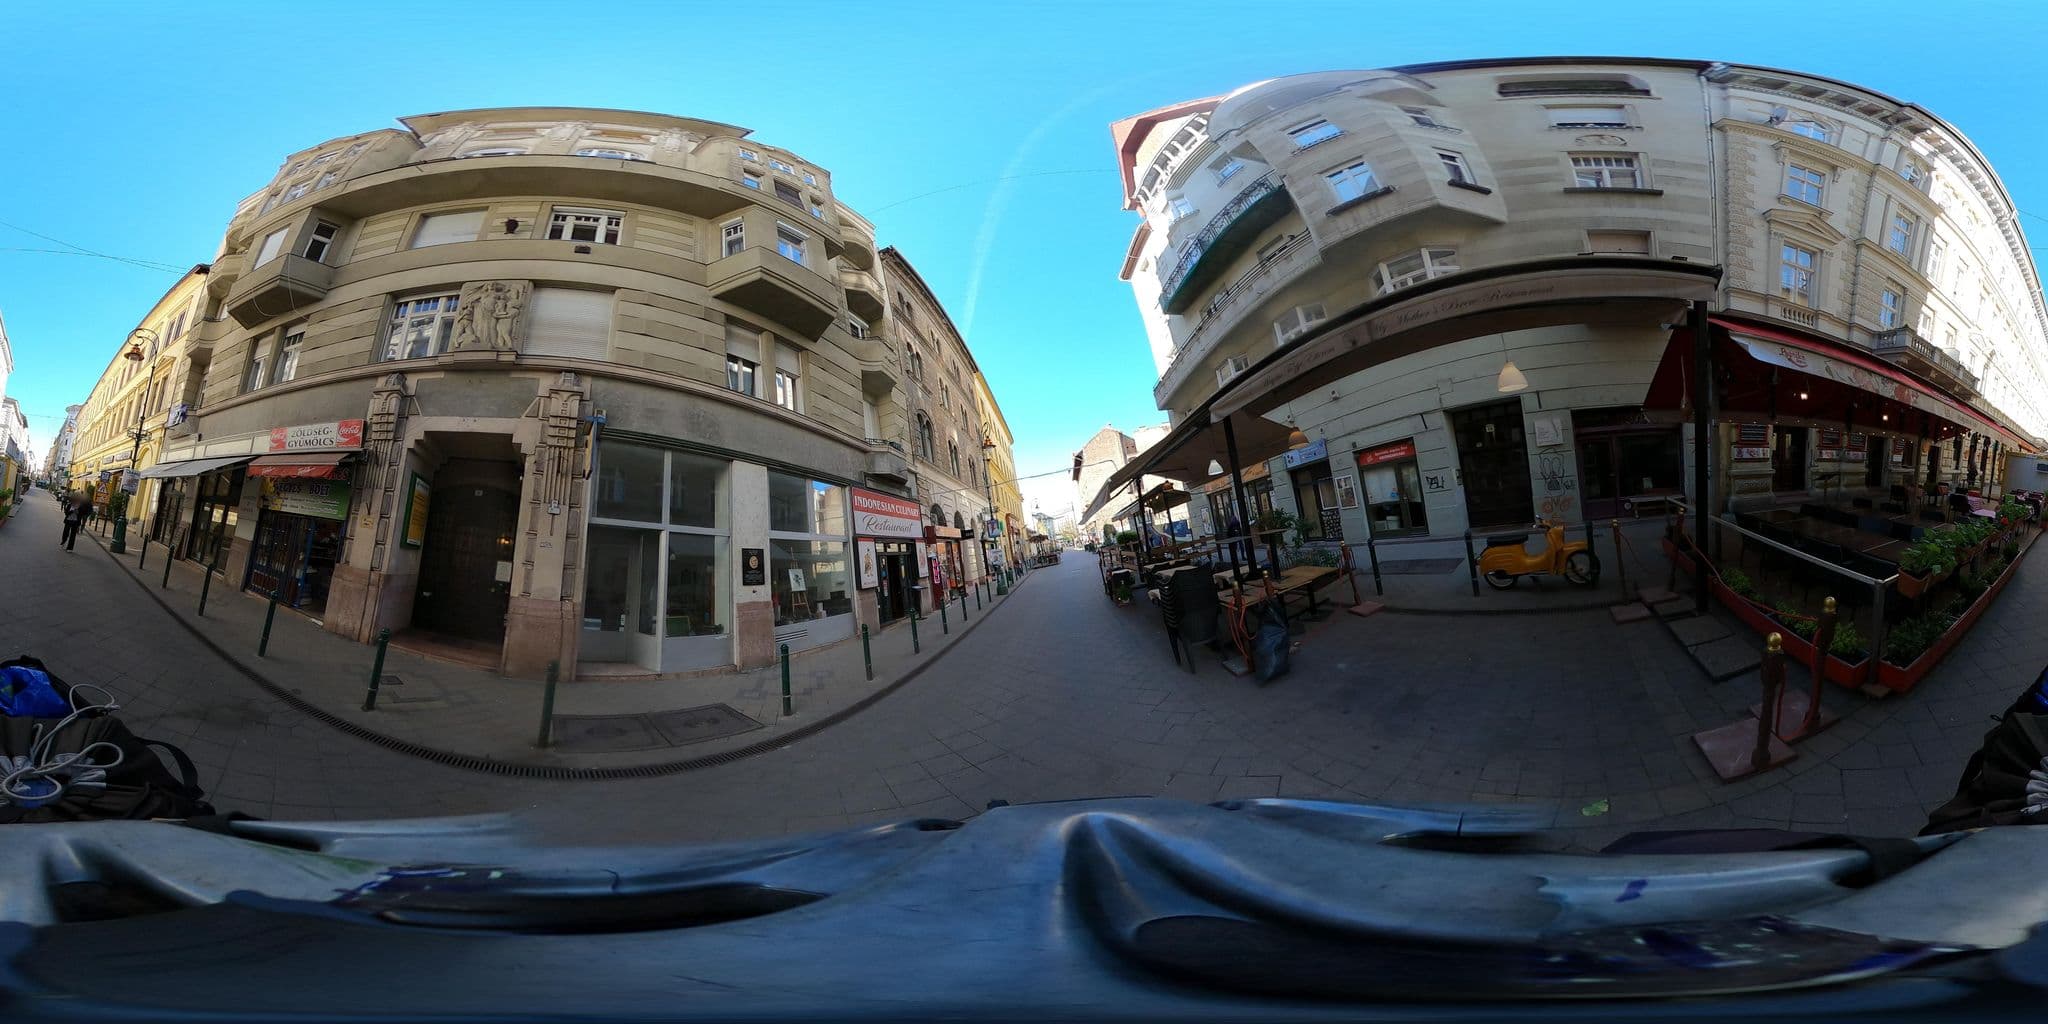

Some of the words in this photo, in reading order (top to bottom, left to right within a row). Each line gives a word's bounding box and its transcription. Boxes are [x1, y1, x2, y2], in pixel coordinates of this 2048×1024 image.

[287, 437, 334, 448] GYÜMÖLCS
[854, 495, 895, 513] INDONESIAN
[895, 504, 920, 517] CULINARY
[862, 514, 913, 534] Restaurant
